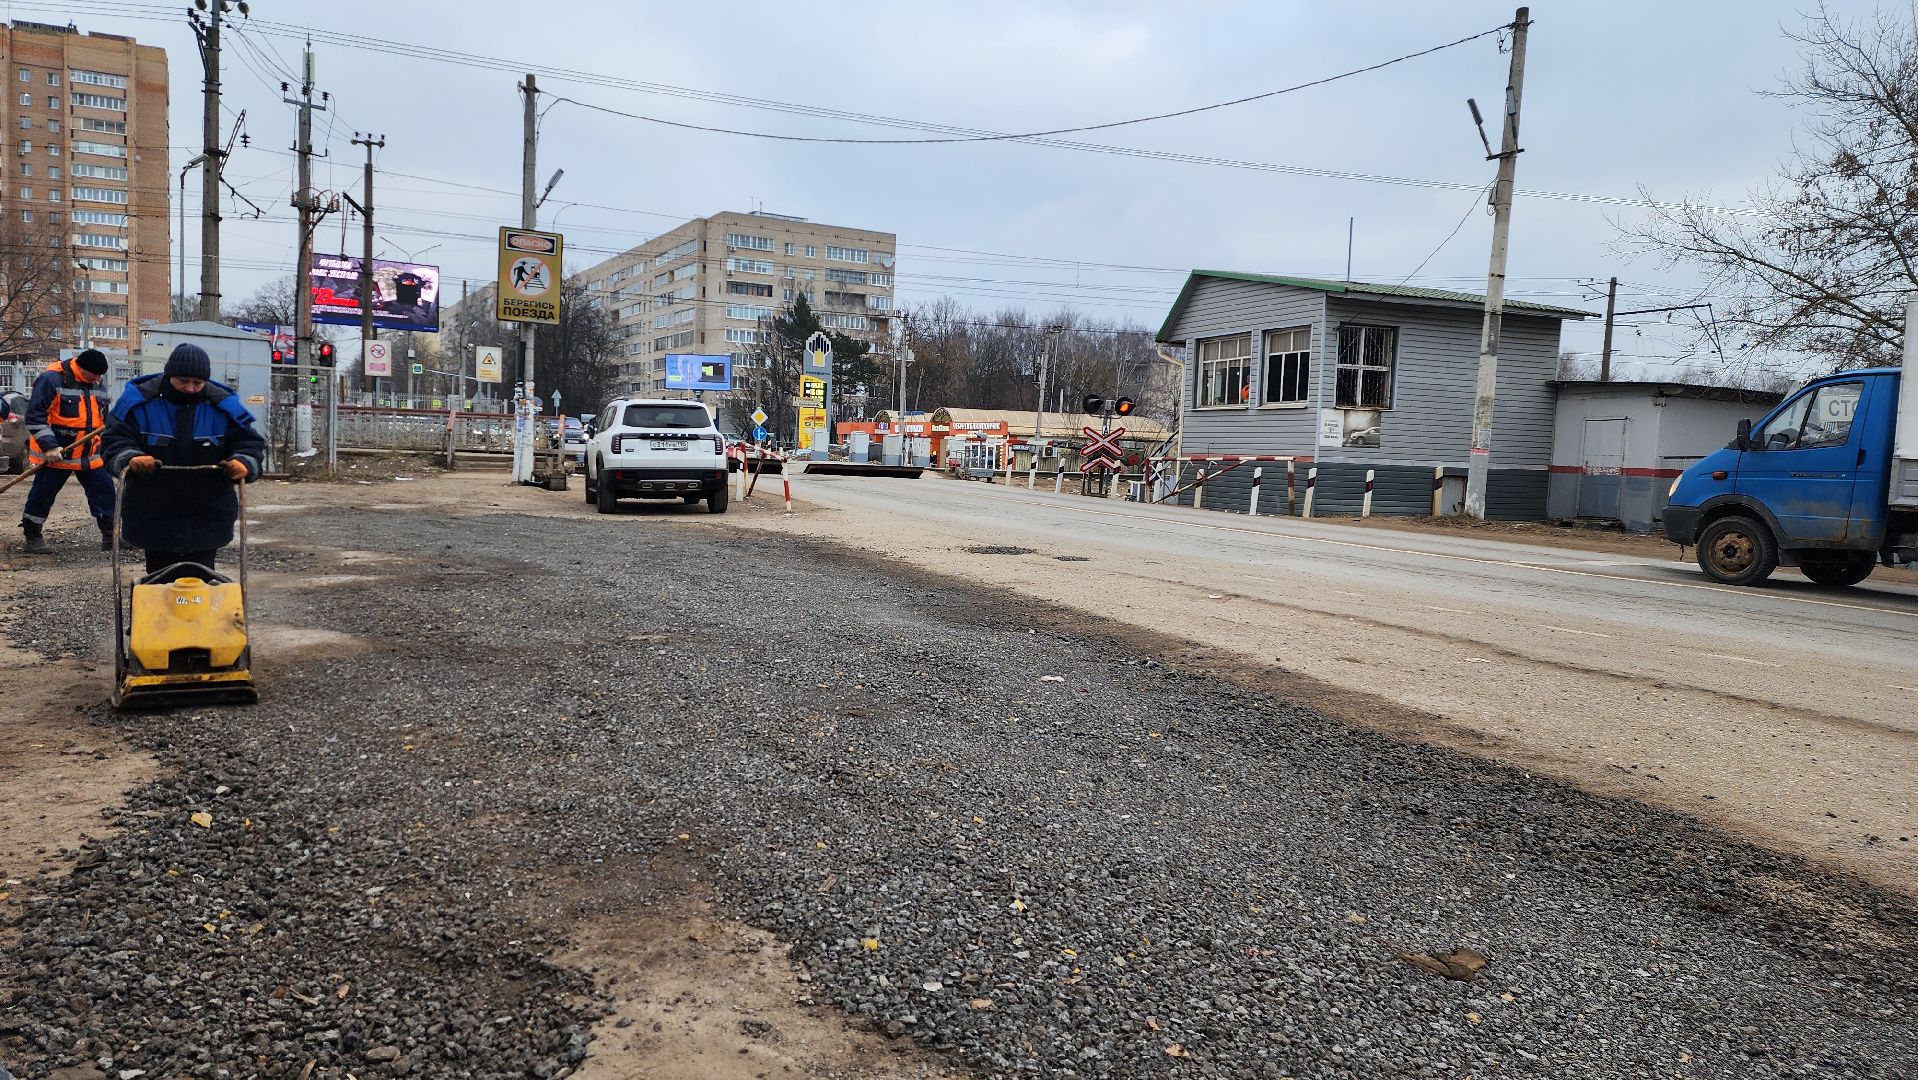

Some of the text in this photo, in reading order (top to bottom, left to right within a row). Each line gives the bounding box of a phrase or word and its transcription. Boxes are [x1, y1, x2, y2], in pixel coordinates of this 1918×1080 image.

[510, 237, 552, 248] ОПАСНО
[503, 298, 555, 310] БЕРЕГИСЬ
[503, 307, 555, 320] ПОЕЗДА
